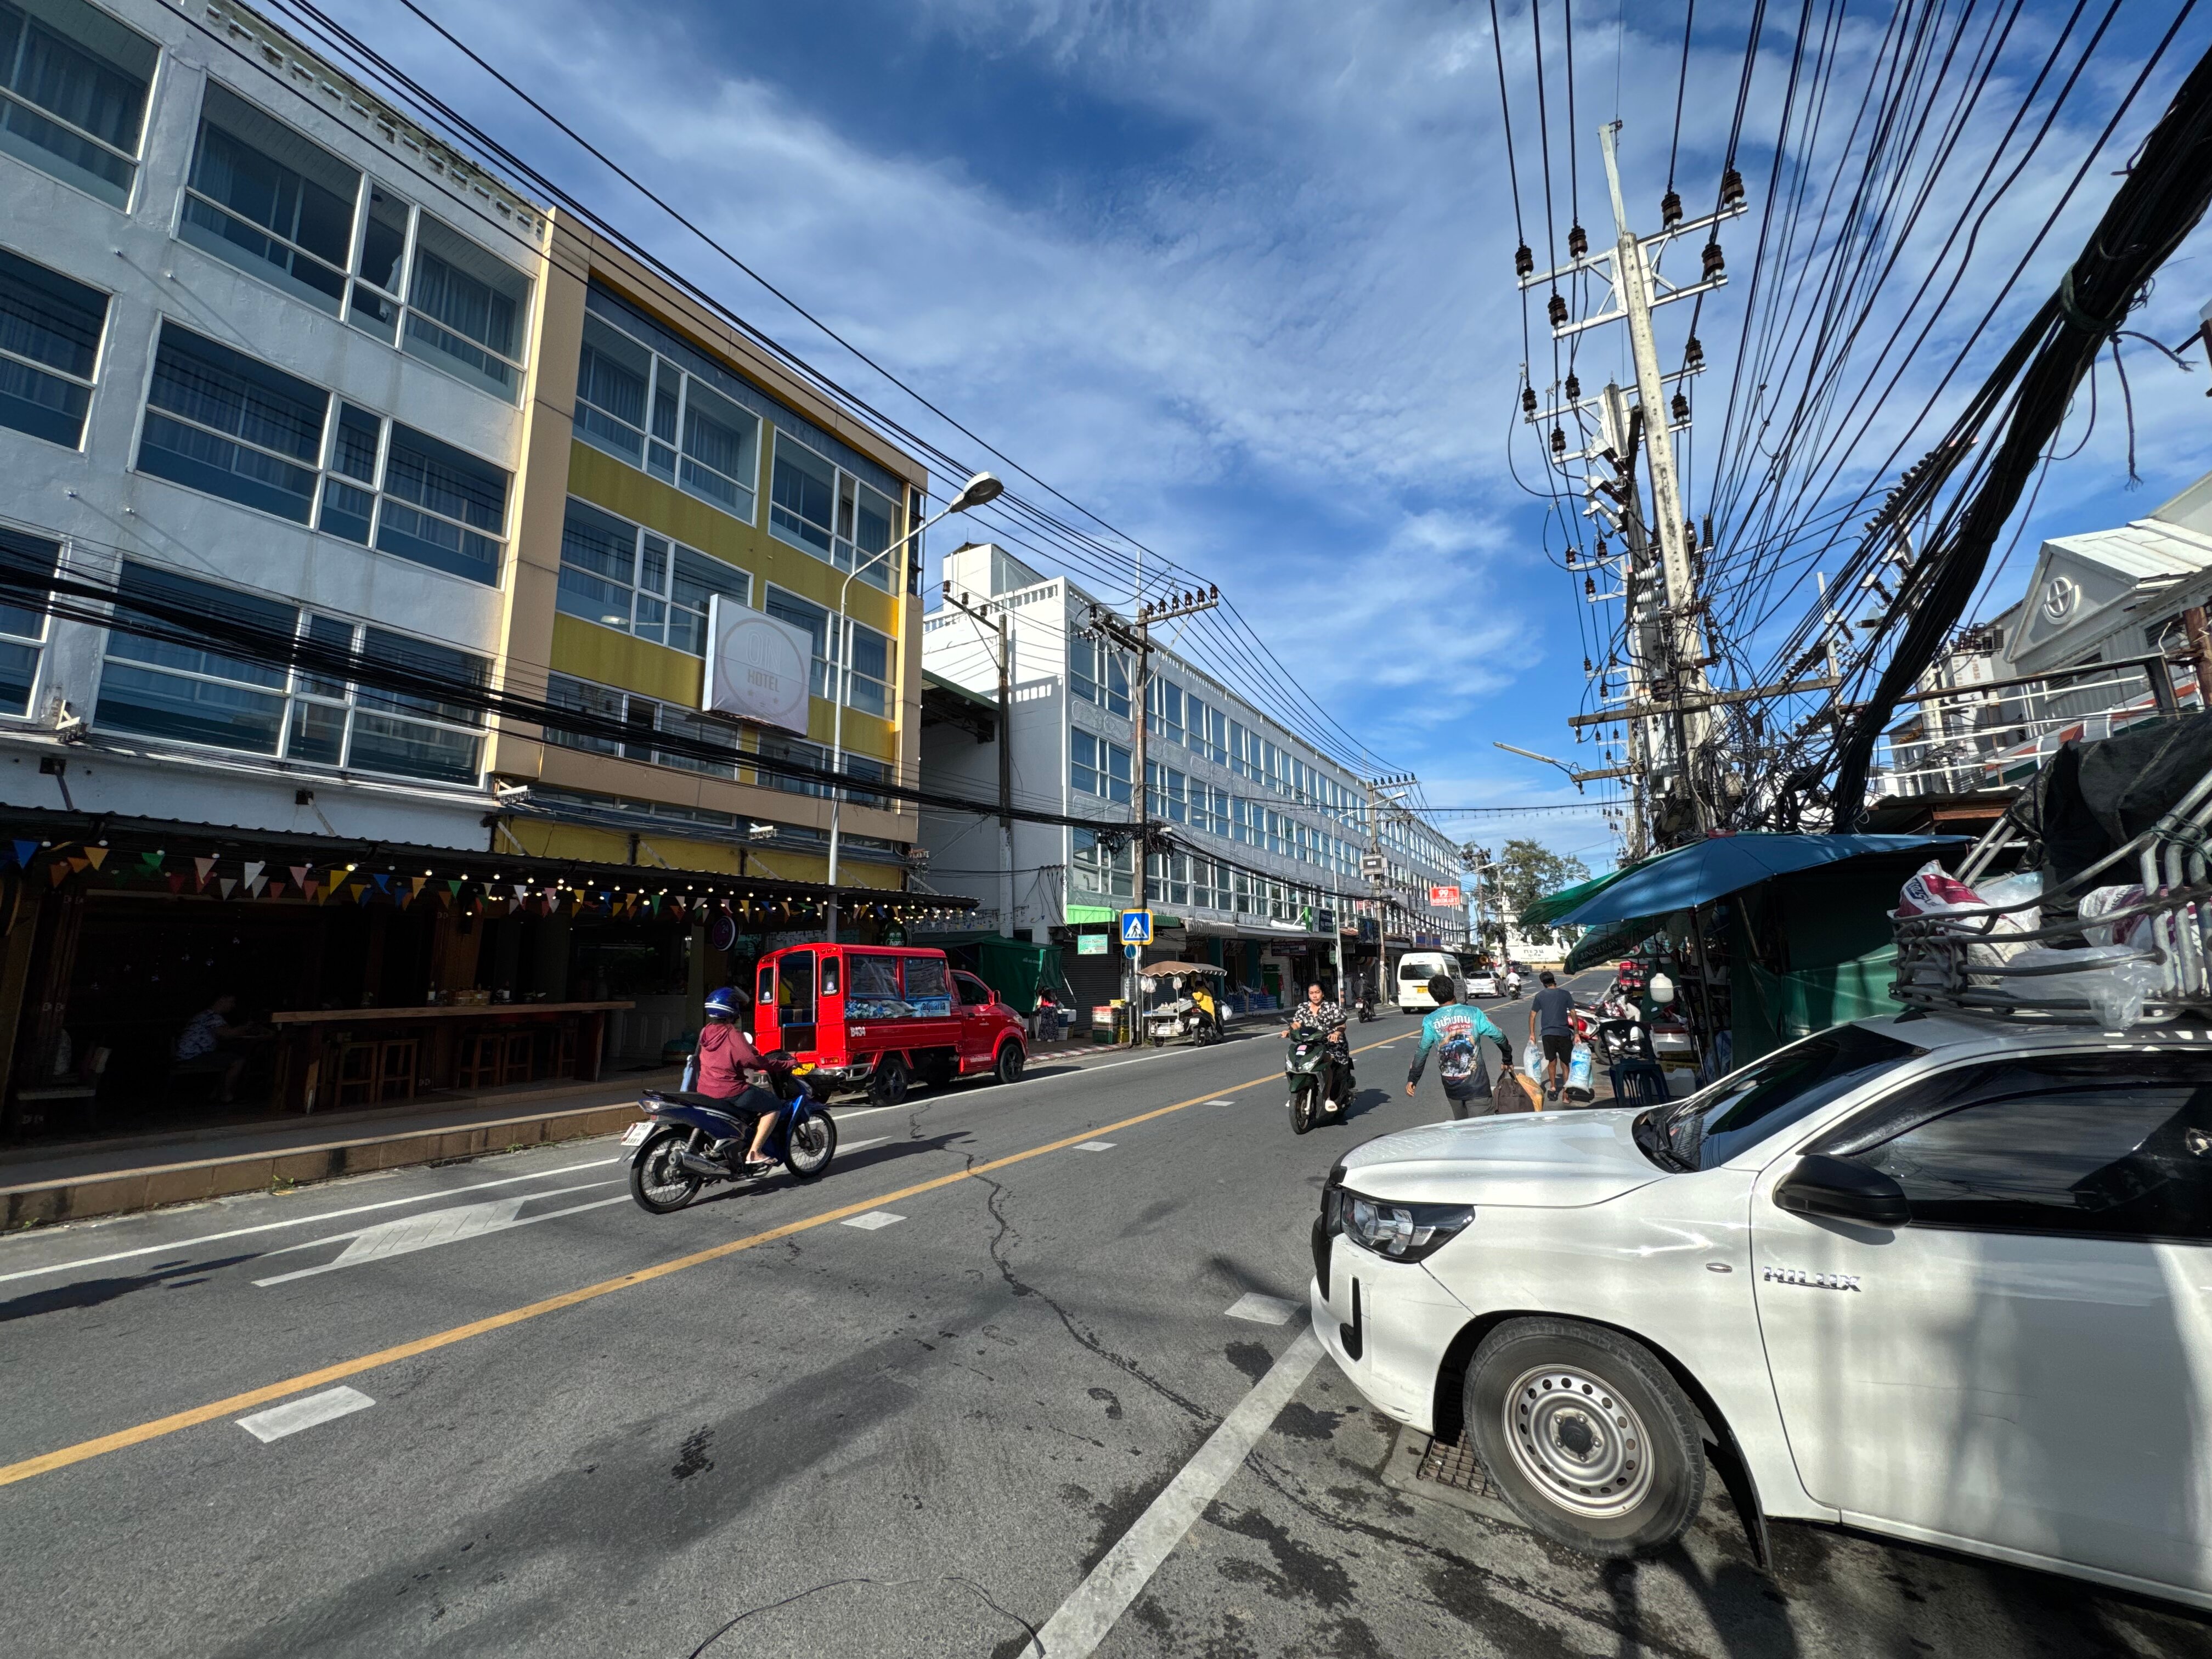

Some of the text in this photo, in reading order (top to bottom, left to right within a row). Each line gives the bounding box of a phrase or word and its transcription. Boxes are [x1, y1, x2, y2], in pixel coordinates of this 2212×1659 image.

[747, 630, 781, 674] ON
[747, 668, 780, 692] HOTEL
[922, 1001, 946, 1013] aquaria
[1763, 1266, 1861, 1293] HILUX
